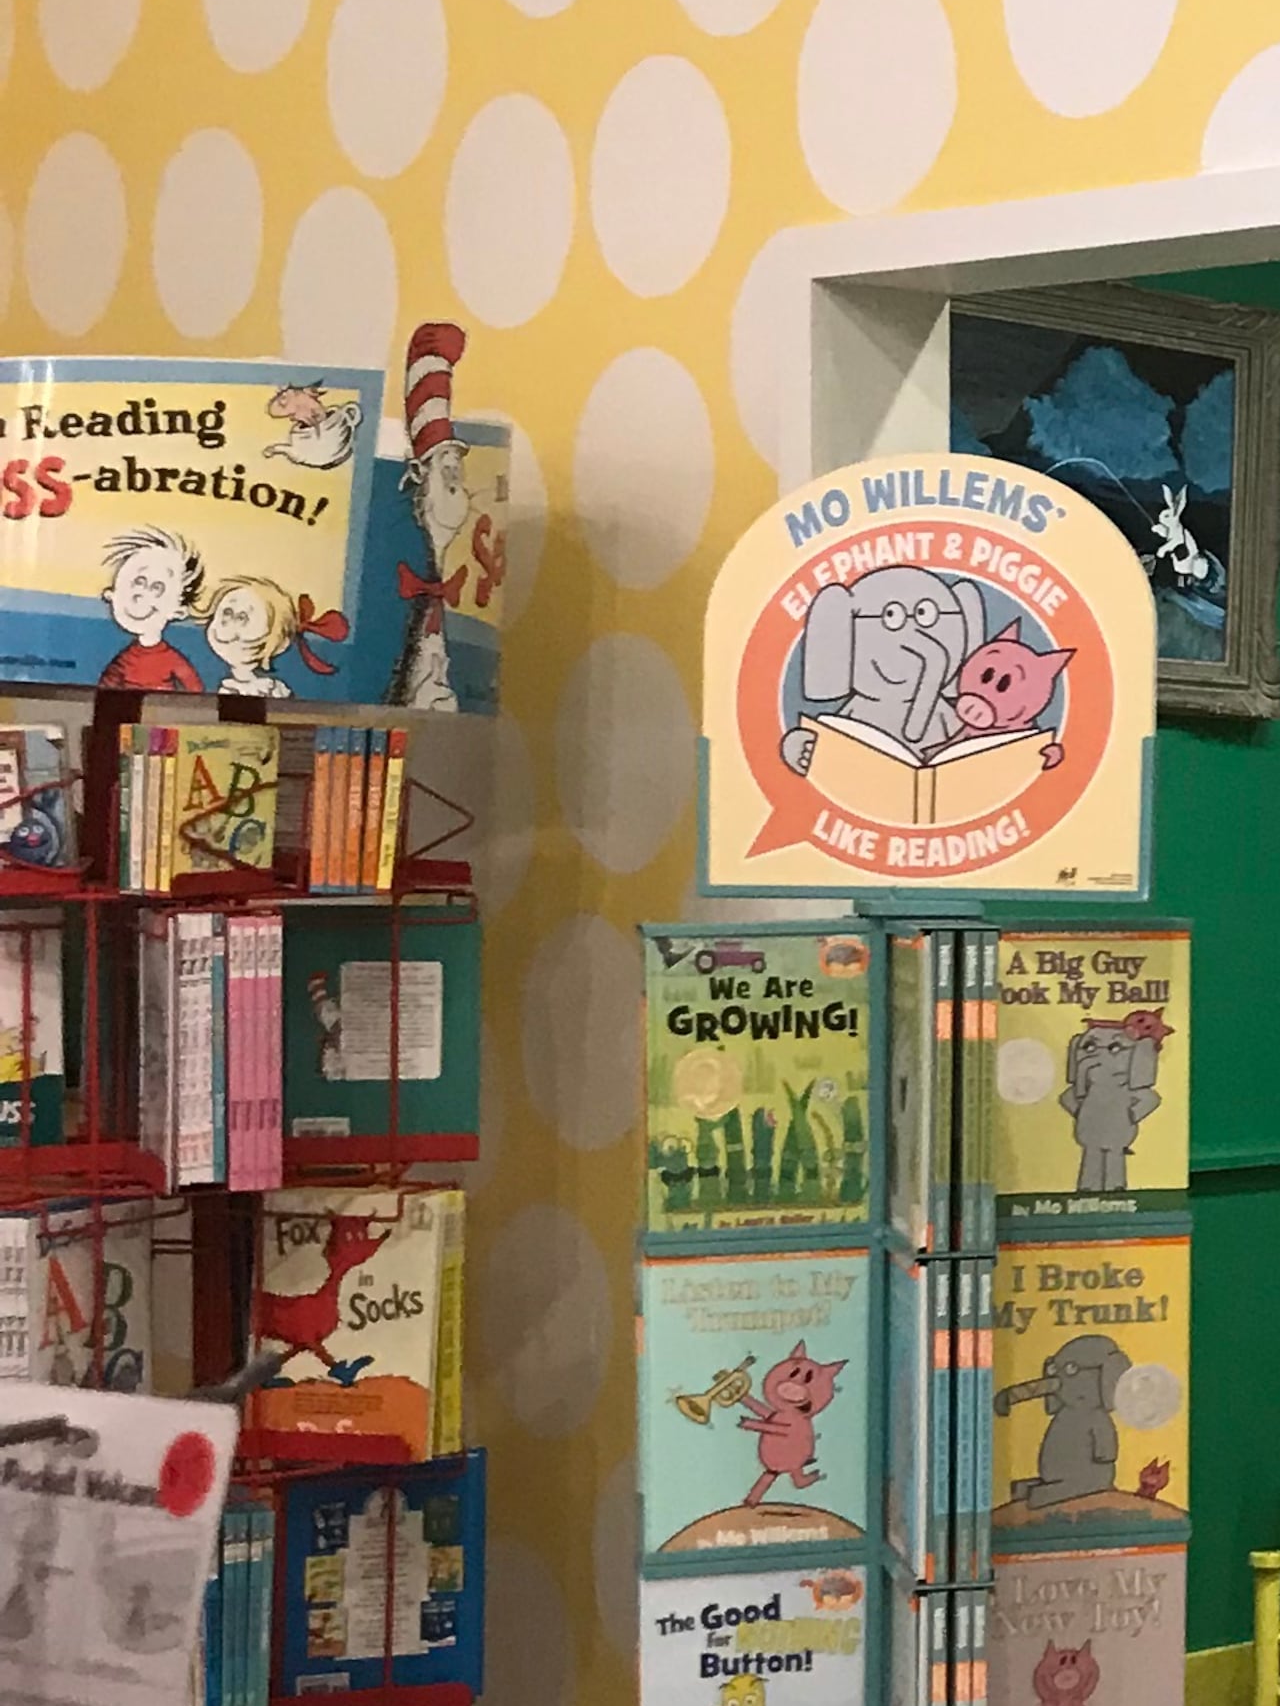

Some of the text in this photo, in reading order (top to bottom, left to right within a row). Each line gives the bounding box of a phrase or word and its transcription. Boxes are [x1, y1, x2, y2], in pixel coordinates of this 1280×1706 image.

[22, 399, 226, 449] Reading
[784, 488, 851, 549] MO
[779, 530, 1069, 623] ELEPHANT & PIGGIE
[812, 808, 1032, 867] LIKE READING!
[1006, 950, 1147, 979] A Big Guy
[709, 977, 814, 1000] We Are
[1000, 980, 1171, 1009] ook My Ball!
[667, 1001, 858, 1042] GROWING!
[274, 1217, 323, 1255] Fox
[357, 1268, 375, 1287] in
[1012, 1262, 1145, 1292] I Broke
[348, 1283, 424, 1331] Socks
[995, 1295, 1169, 1334] My Trunk!
[1011, 1568, 1167, 1605] Love My
[656, 1593, 781, 1636] The Good
[700, 1649, 814, 1678] Button!
